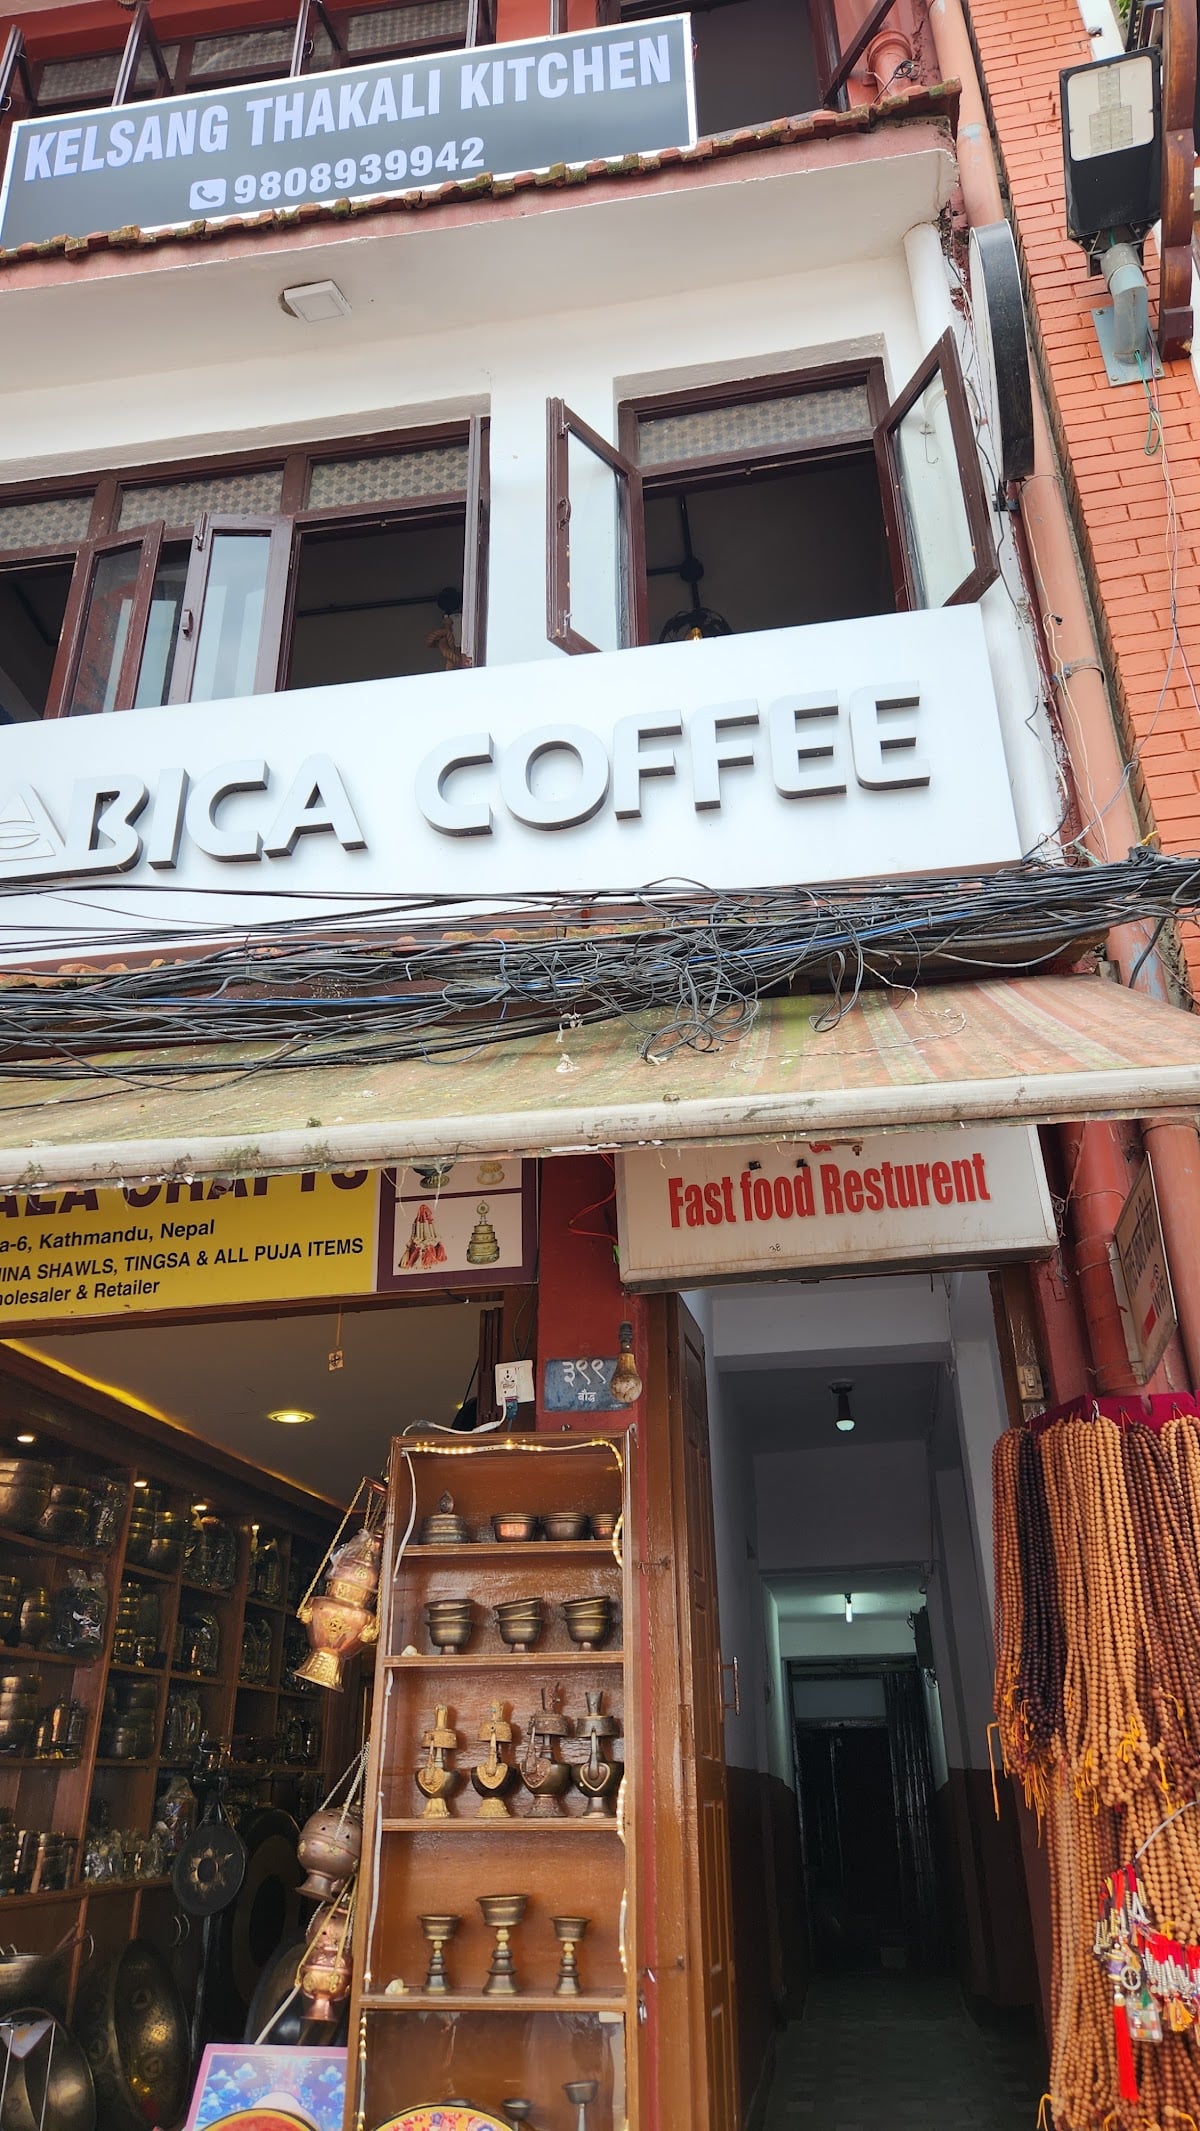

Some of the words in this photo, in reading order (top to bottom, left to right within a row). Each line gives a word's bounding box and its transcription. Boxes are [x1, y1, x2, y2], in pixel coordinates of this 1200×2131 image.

[24, 105, 228, 182] KELSANG
[245, 69, 441, 143] THAKALI
[460, 34, 672, 110] KITCHEN
[233, 136, 485, 204] 9808939942
[414, 681, 931, 838] COFFEE
[668, 1175, 736, 1228] Fast
[740, 1165, 815, 1221] food
[820, 1152, 990, 1215] Resturent
[0, 1266, 31, 1282] INA
[37, 1258, 118, 1280] SHAWLS,
[124, 1252, 191, 1272] TINGSA
[196, 1250, 208, 1266] &
[214, 1247, 249, 1265] ALL
[254, 1243, 302, 1262] PUJA
[307, 1237, 364, 1257] ITEMS
[39, 1226, 153, 1249] Kathmandu,
[160, 1219, 215, 1240] Nepal
[76, 1284, 88, 1300] &
[94, 1279, 160, 1299] Retailer
